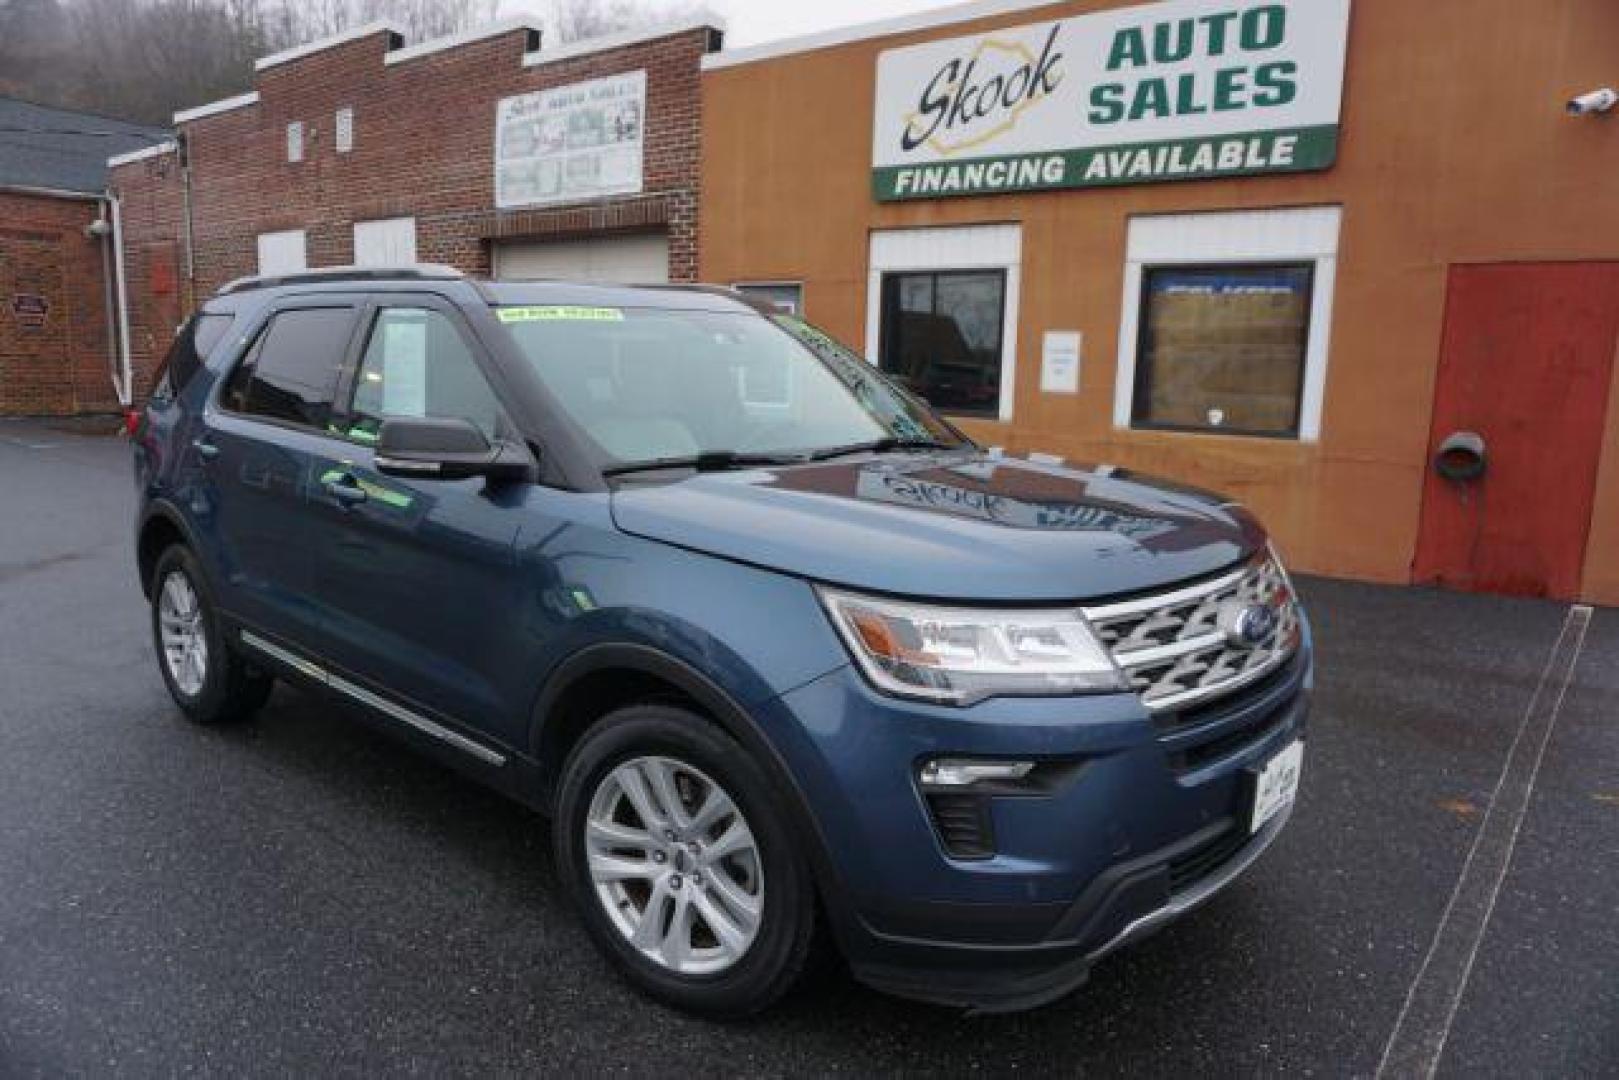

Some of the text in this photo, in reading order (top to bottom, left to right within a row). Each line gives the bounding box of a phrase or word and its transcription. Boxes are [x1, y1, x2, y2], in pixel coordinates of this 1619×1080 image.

[1105, 5, 1286, 71] AUTO
[902, 23, 1063, 152] Skook
[1087, 61, 1298, 124] SALES
[895, 134, 1298, 193] FINANCING AVAILABLE
